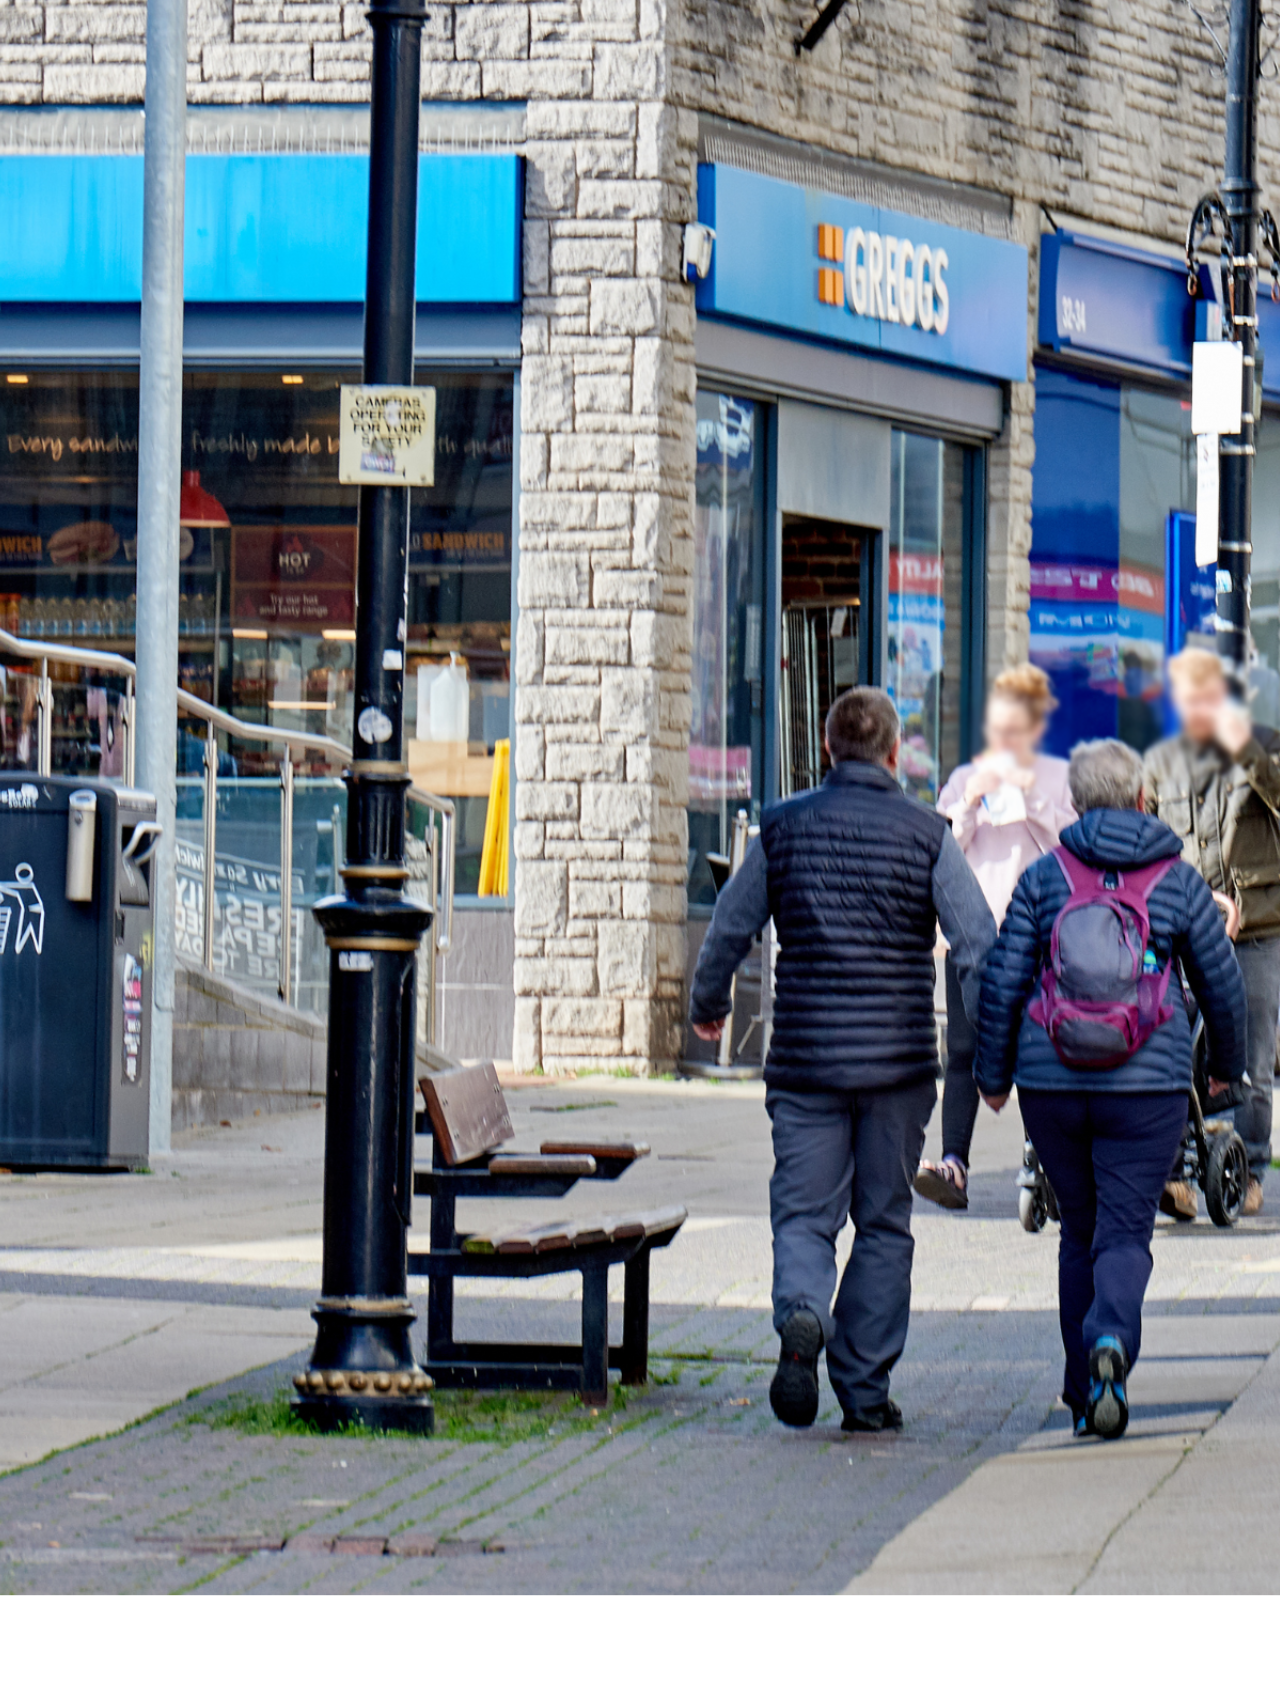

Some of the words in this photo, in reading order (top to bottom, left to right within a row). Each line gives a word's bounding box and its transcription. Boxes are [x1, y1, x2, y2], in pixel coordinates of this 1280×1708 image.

[844, 226, 949, 335] GREGGS
[350, 408, 426, 422] OPERTING
[353, 420, 381, 434] FOR
[385, 420, 422, 434] YOUR
[8, 433, 63, 461] Every
[69, 431, 138, 454] sandw
[193, 429, 258, 461] freshly
[264, 431, 321, 454] made
[422, 532, 505, 551] SANDWICH
[278, 552, 311, 569] HOT
